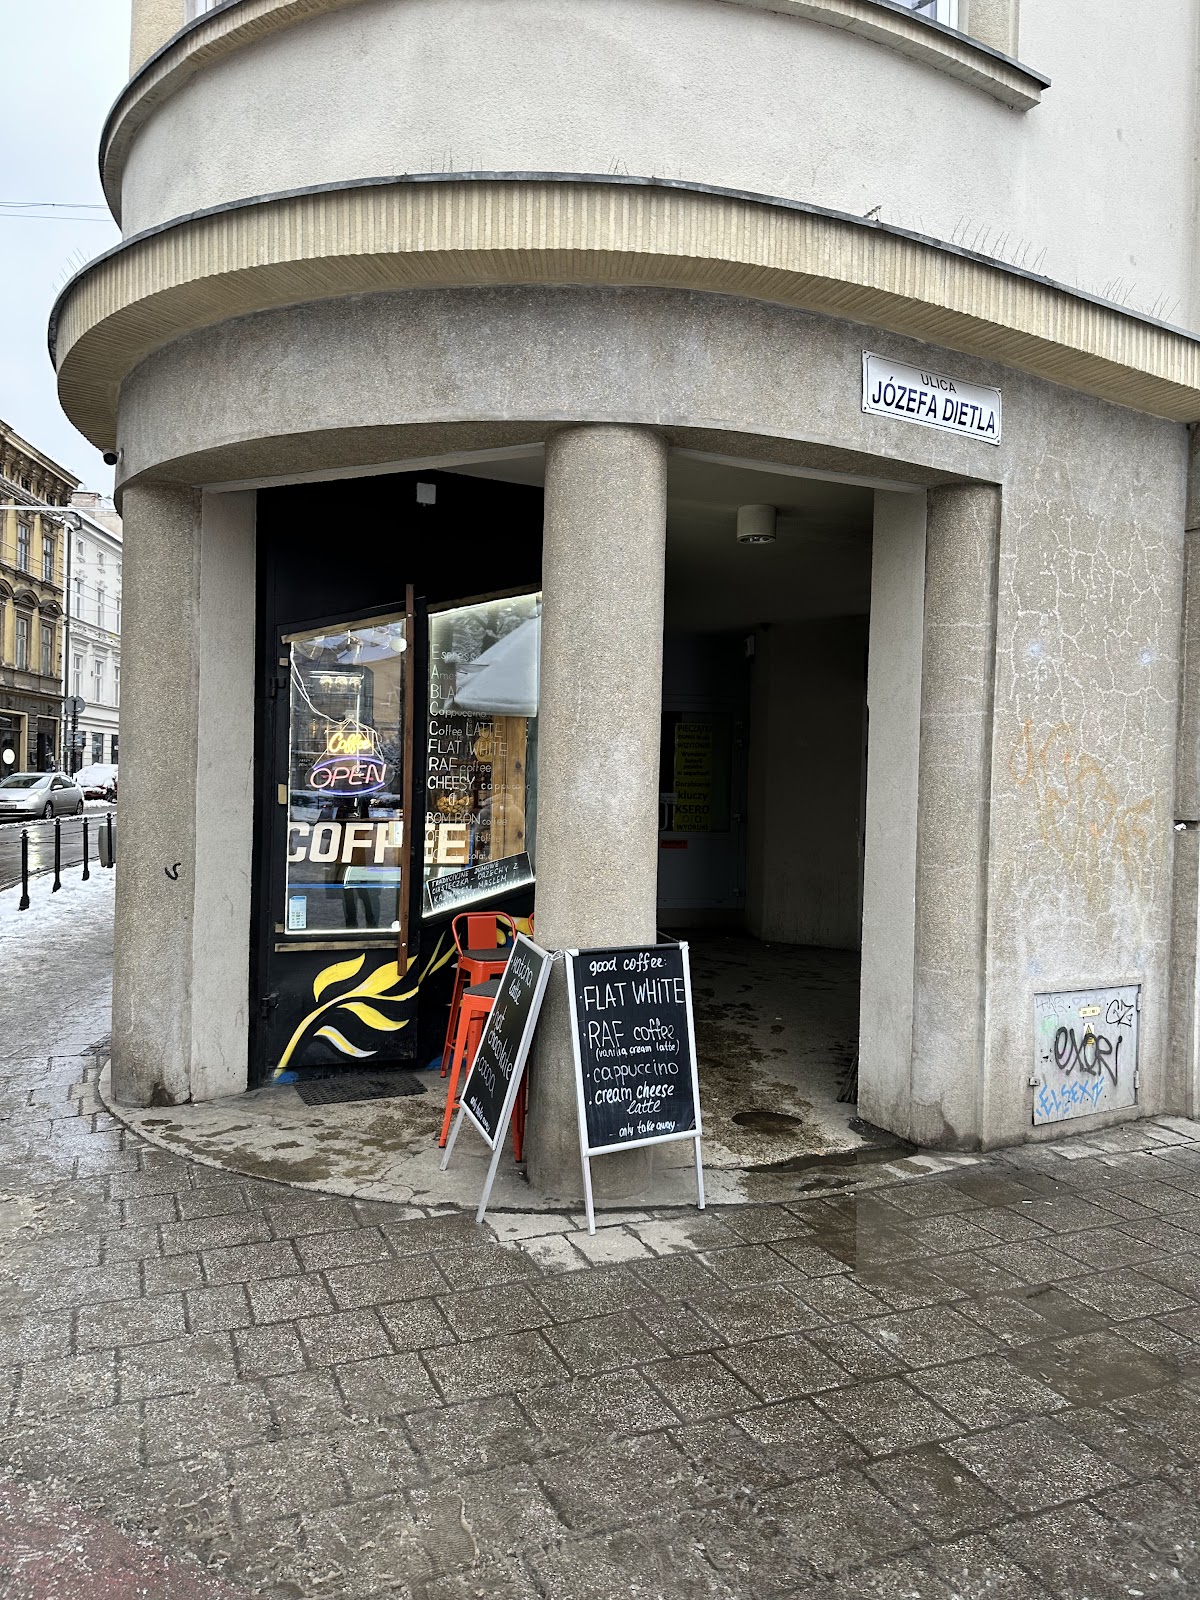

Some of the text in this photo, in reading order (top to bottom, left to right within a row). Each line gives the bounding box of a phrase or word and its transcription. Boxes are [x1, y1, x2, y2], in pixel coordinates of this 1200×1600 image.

[920, 373, 957, 394] ULICA
[872, 376, 996, 434] JÓZEFA DIETLA
[429, 720, 503, 738] Coffee LATTE
[328, 732, 372, 754] Coffee
[428, 738, 507, 757] FLAT WHITE
[428, 757, 492, 773] RAF coffee
[310, 764, 387, 788] OPEN
[427, 775, 476, 791] CHEESY
[426, 811, 451, 824] BOM
[455, 812, 480, 825] BON
[675, 804, 710, 815] KSERO
[589, 952, 668, 976] good coffee:
[583, 982, 627, 1011] FLAT
[588, 1017, 675, 1050] RAF coffee
[629, 1044, 652, 1056] cream
[593, 1059, 679, 1086] cappuccino
[594, 1081, 675, 1105] cream cheese
[626, 1098, 662, 1115] latte
[619, 1120, 676, 1137] only take away
